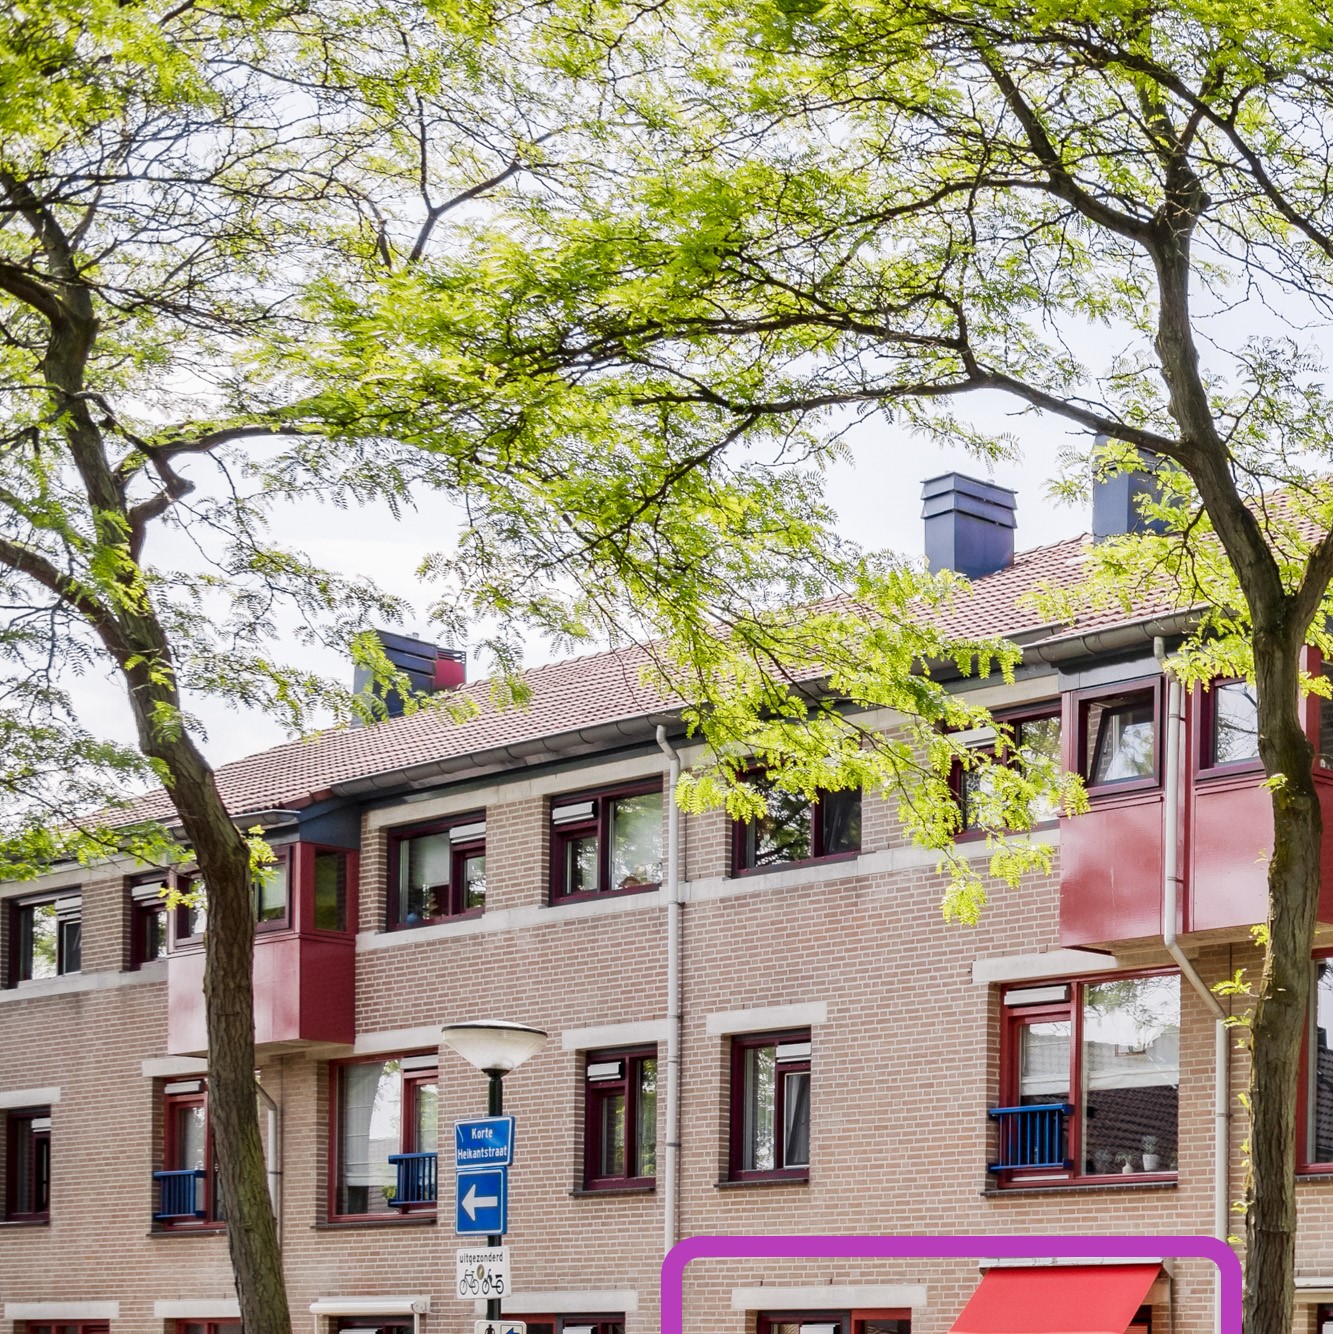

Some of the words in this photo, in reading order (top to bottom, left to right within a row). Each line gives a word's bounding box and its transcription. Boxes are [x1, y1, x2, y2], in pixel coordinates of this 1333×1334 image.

[471, 1127, 493, 1139] Korte
[457, 1145, 507, 1160] Heikantstraat
[460, 1252, 503, 1266] uitgezonderd
